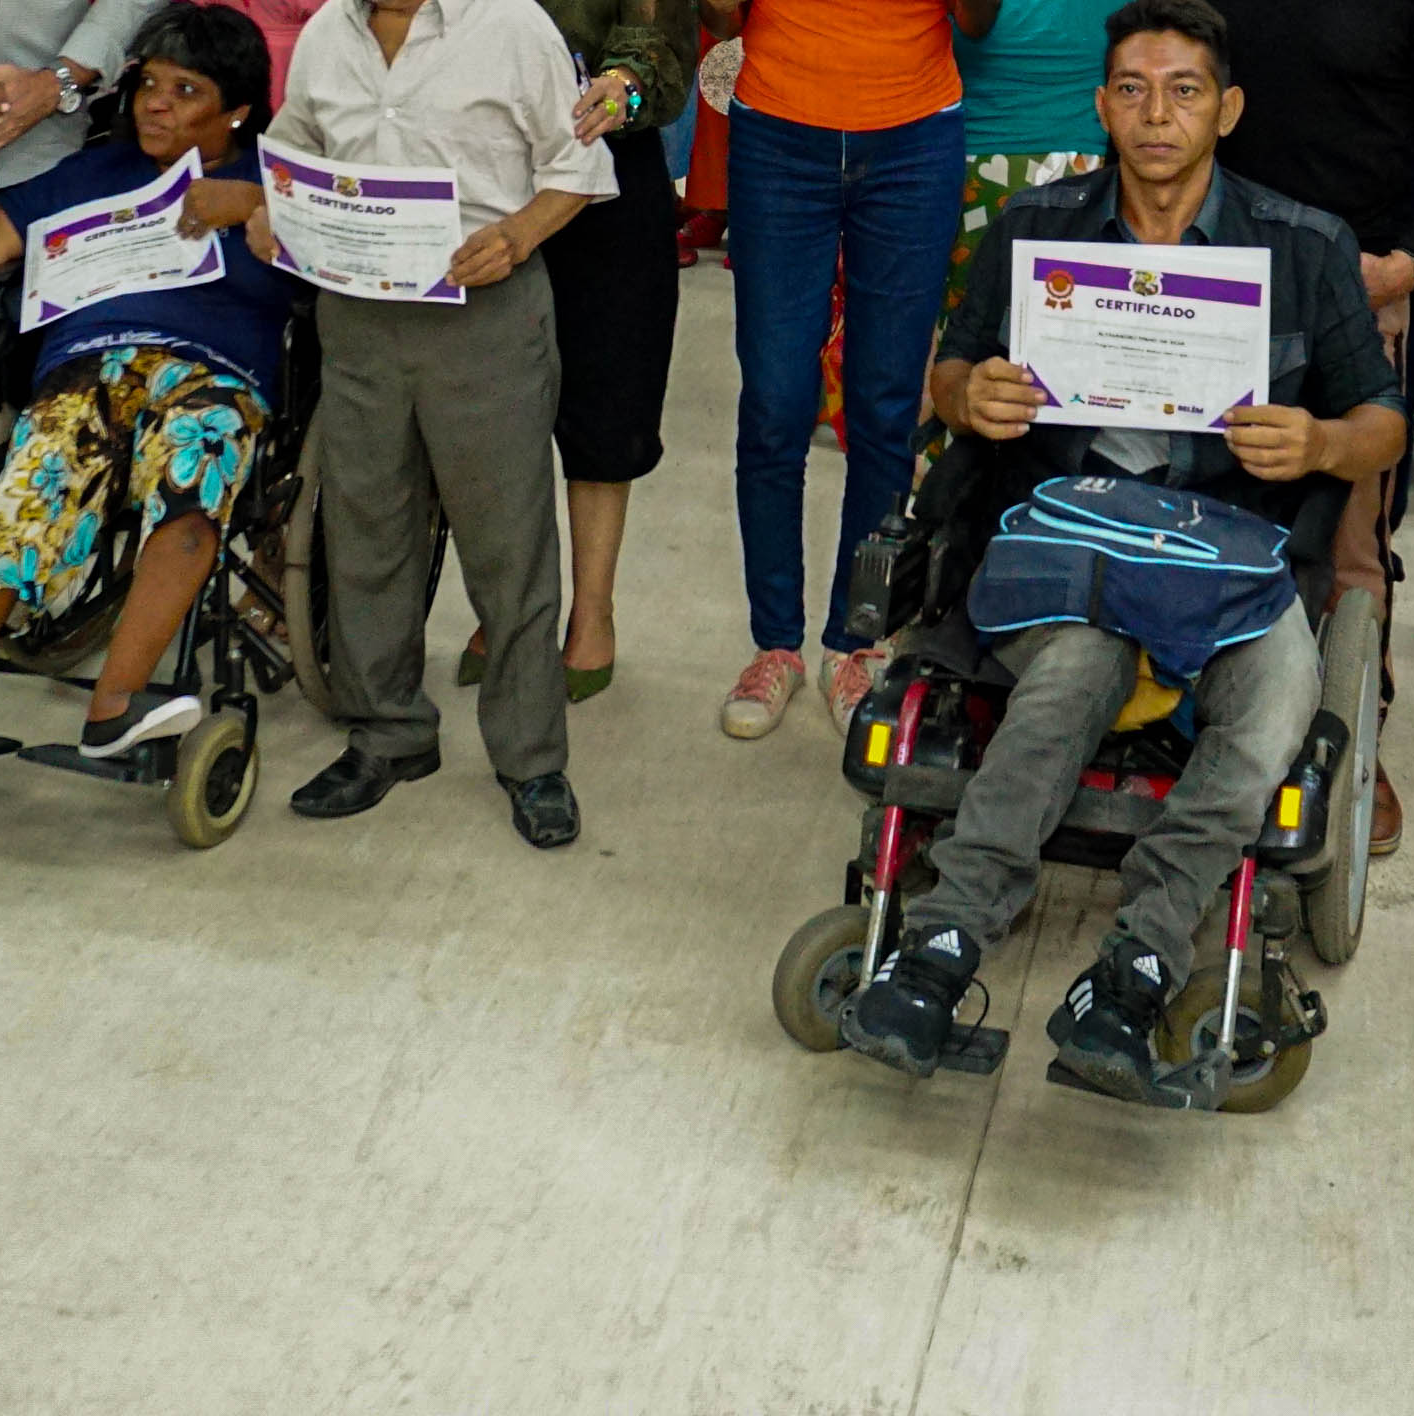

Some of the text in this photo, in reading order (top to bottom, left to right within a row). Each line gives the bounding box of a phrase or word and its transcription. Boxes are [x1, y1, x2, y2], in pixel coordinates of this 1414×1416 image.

[308, 194, 395, 215] CERTIFICADO
[84, 217, 166, 242] CERTIFICADO
[1095, 298, 1195, 318] CERTIFICADO
